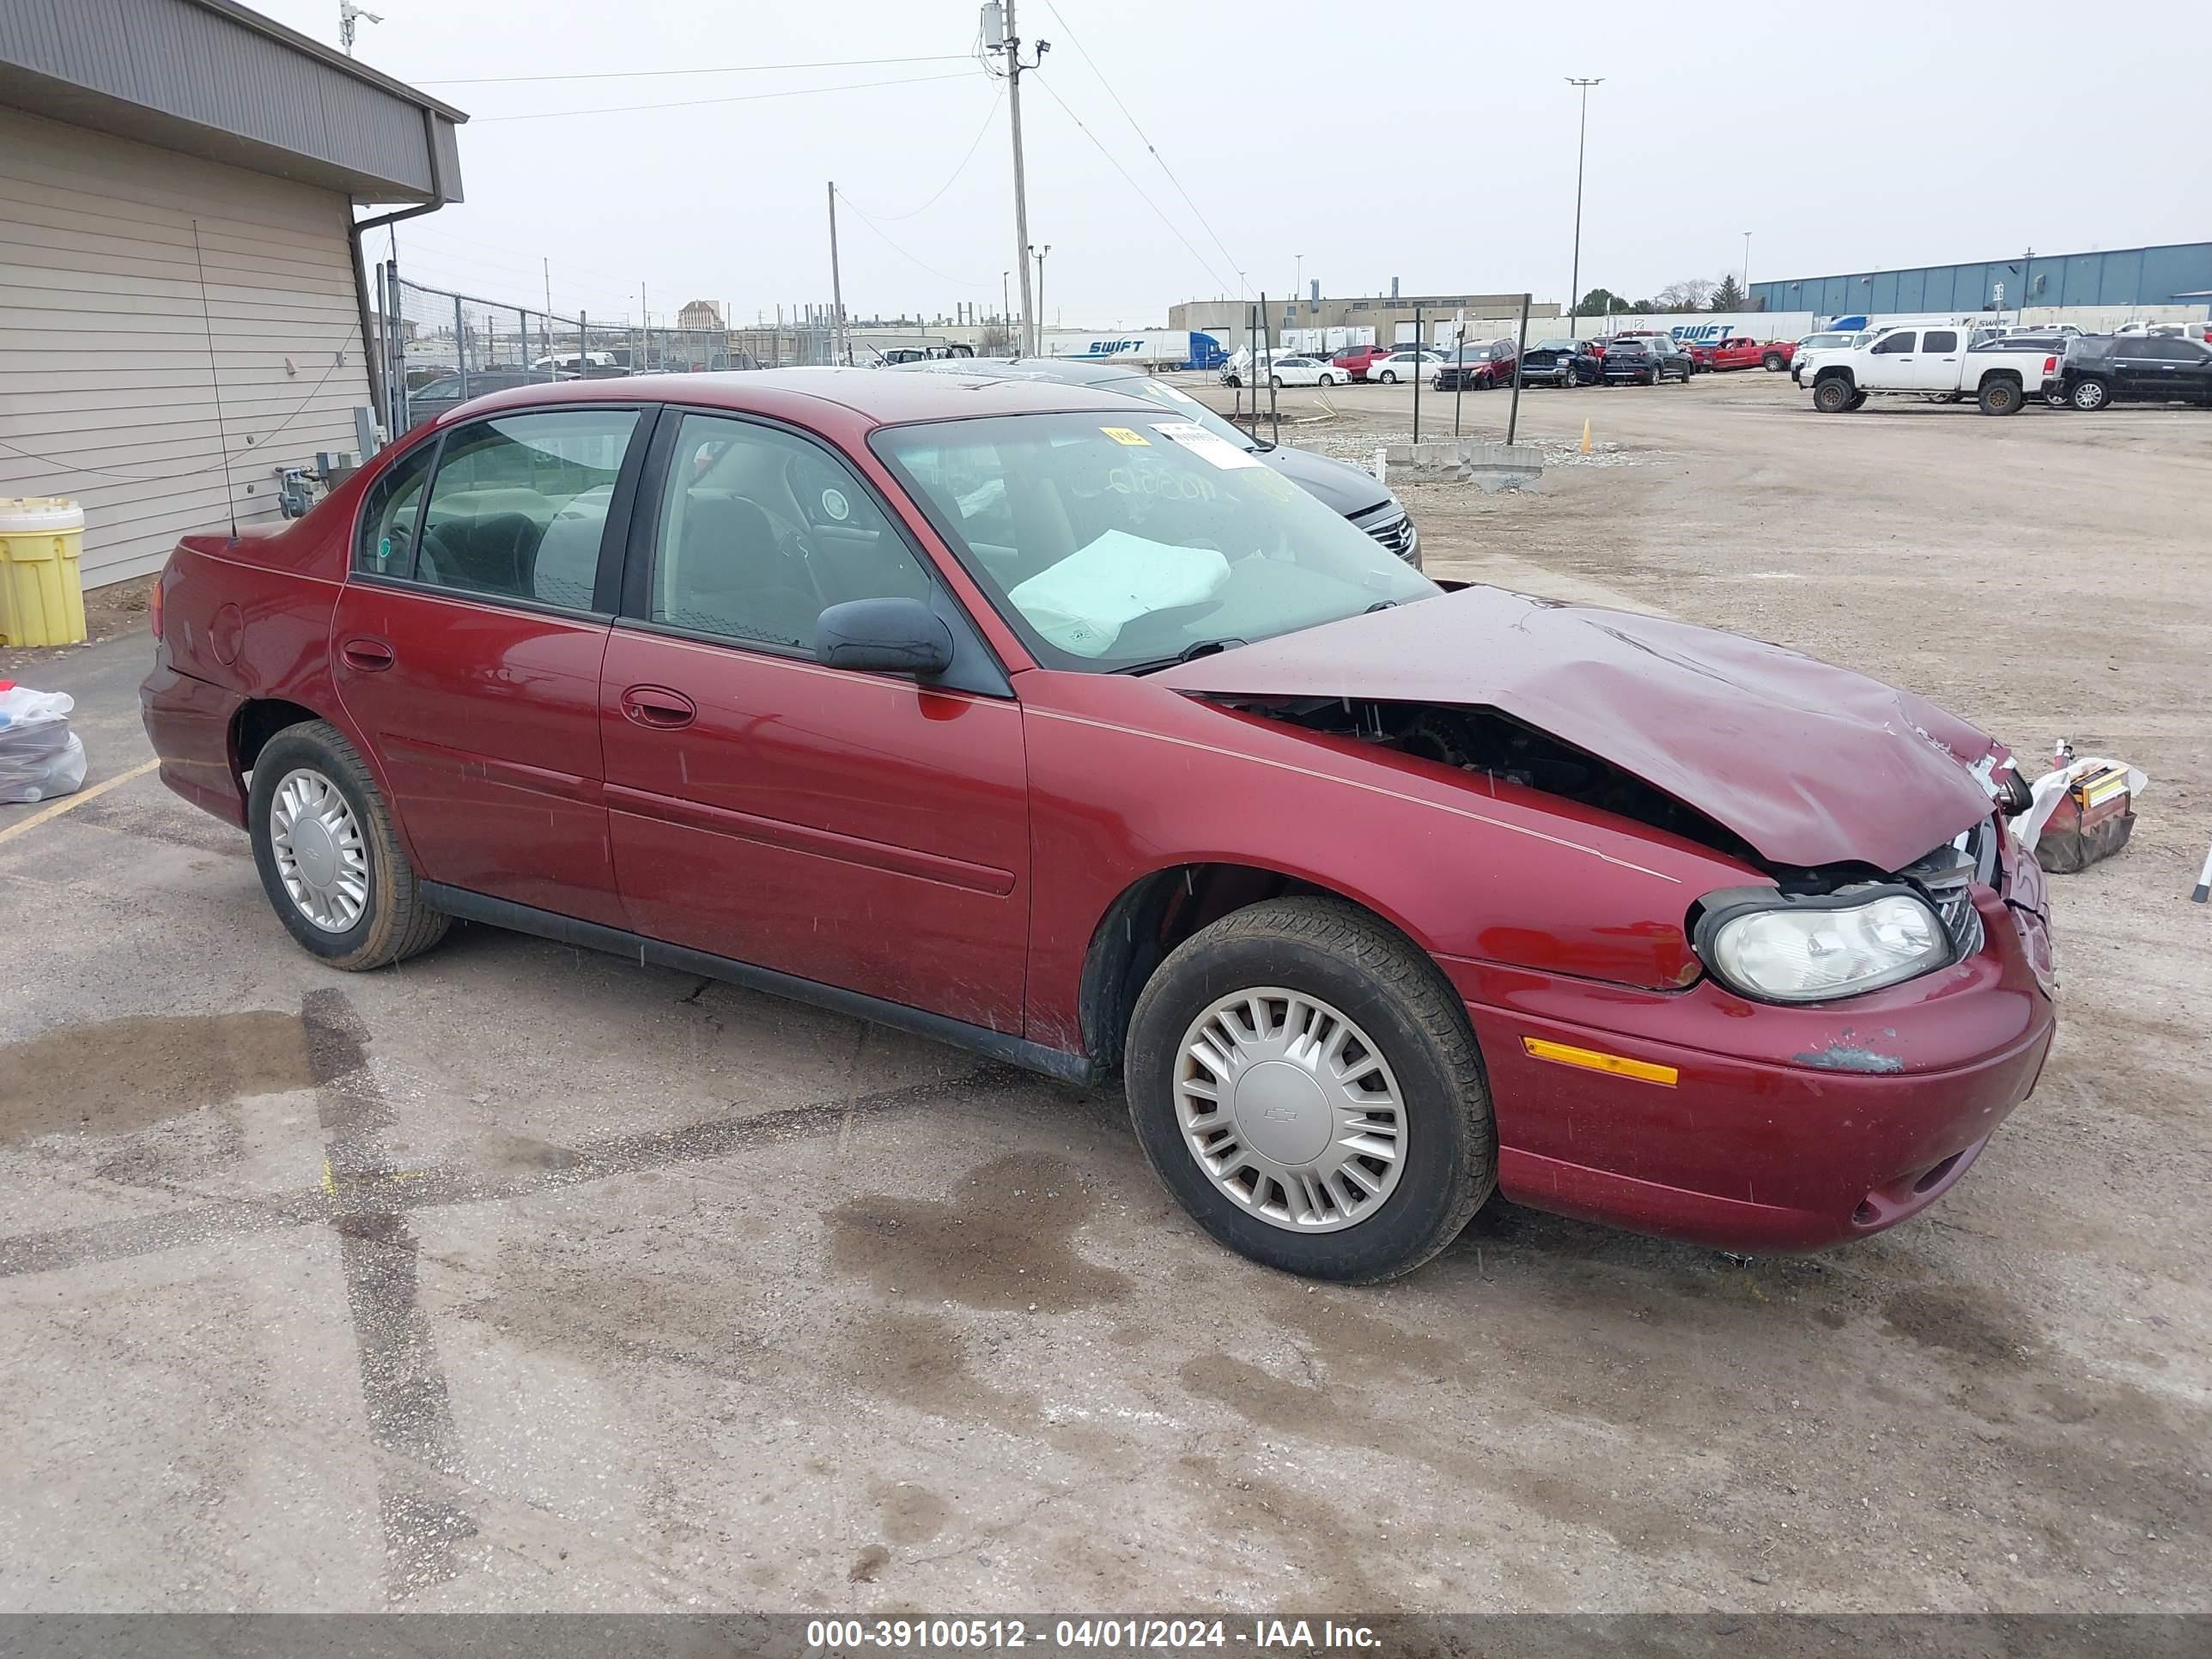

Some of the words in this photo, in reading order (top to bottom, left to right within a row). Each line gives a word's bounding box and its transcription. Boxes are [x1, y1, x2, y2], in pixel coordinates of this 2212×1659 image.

[1671, 325, 1735, 339] SWIFT
[1088, 340, 1145, 353] SWIFT
[1106, 430, 1142, 442] VIC
